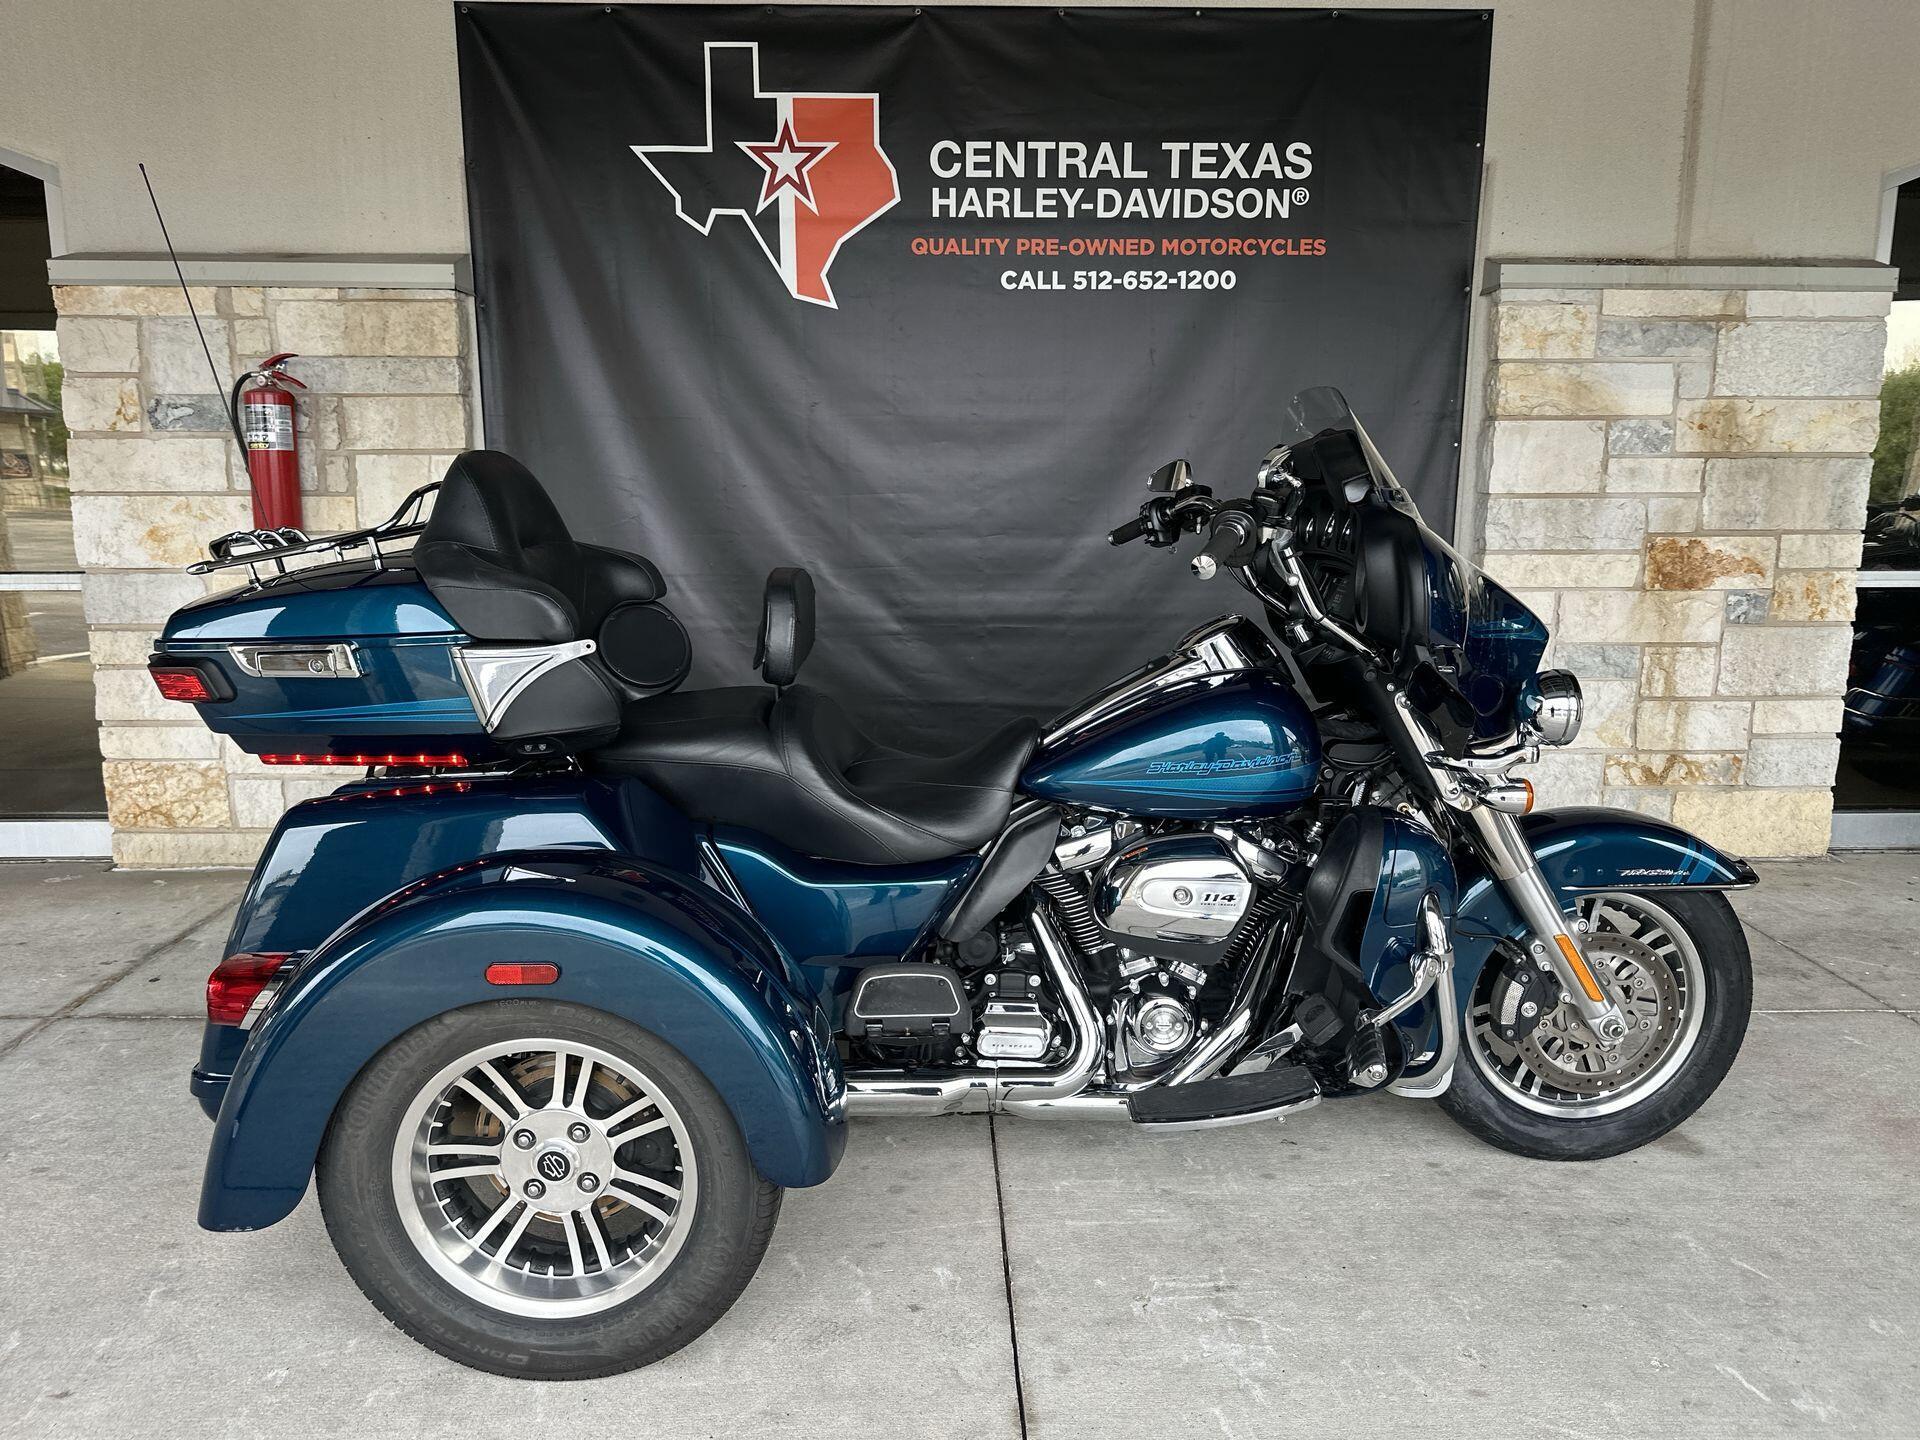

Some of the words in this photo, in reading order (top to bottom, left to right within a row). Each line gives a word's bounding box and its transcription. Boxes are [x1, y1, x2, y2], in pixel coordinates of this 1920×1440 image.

[929, 139, 1148, 179] CENTRAL
[1161, 141, 1313, 180] TEXAS
[911, 237, 1010, 256] QUALITY
[1016, 238, 1155, 256] PRE-OWNED
[1161, 238, 1327, 256] MOTORCYCLES
[1000, 270, 1067, 290] CALL
[1072, 269, 1237, 291] 512-652-1200
[1203, 893, 1237, 903] 114
